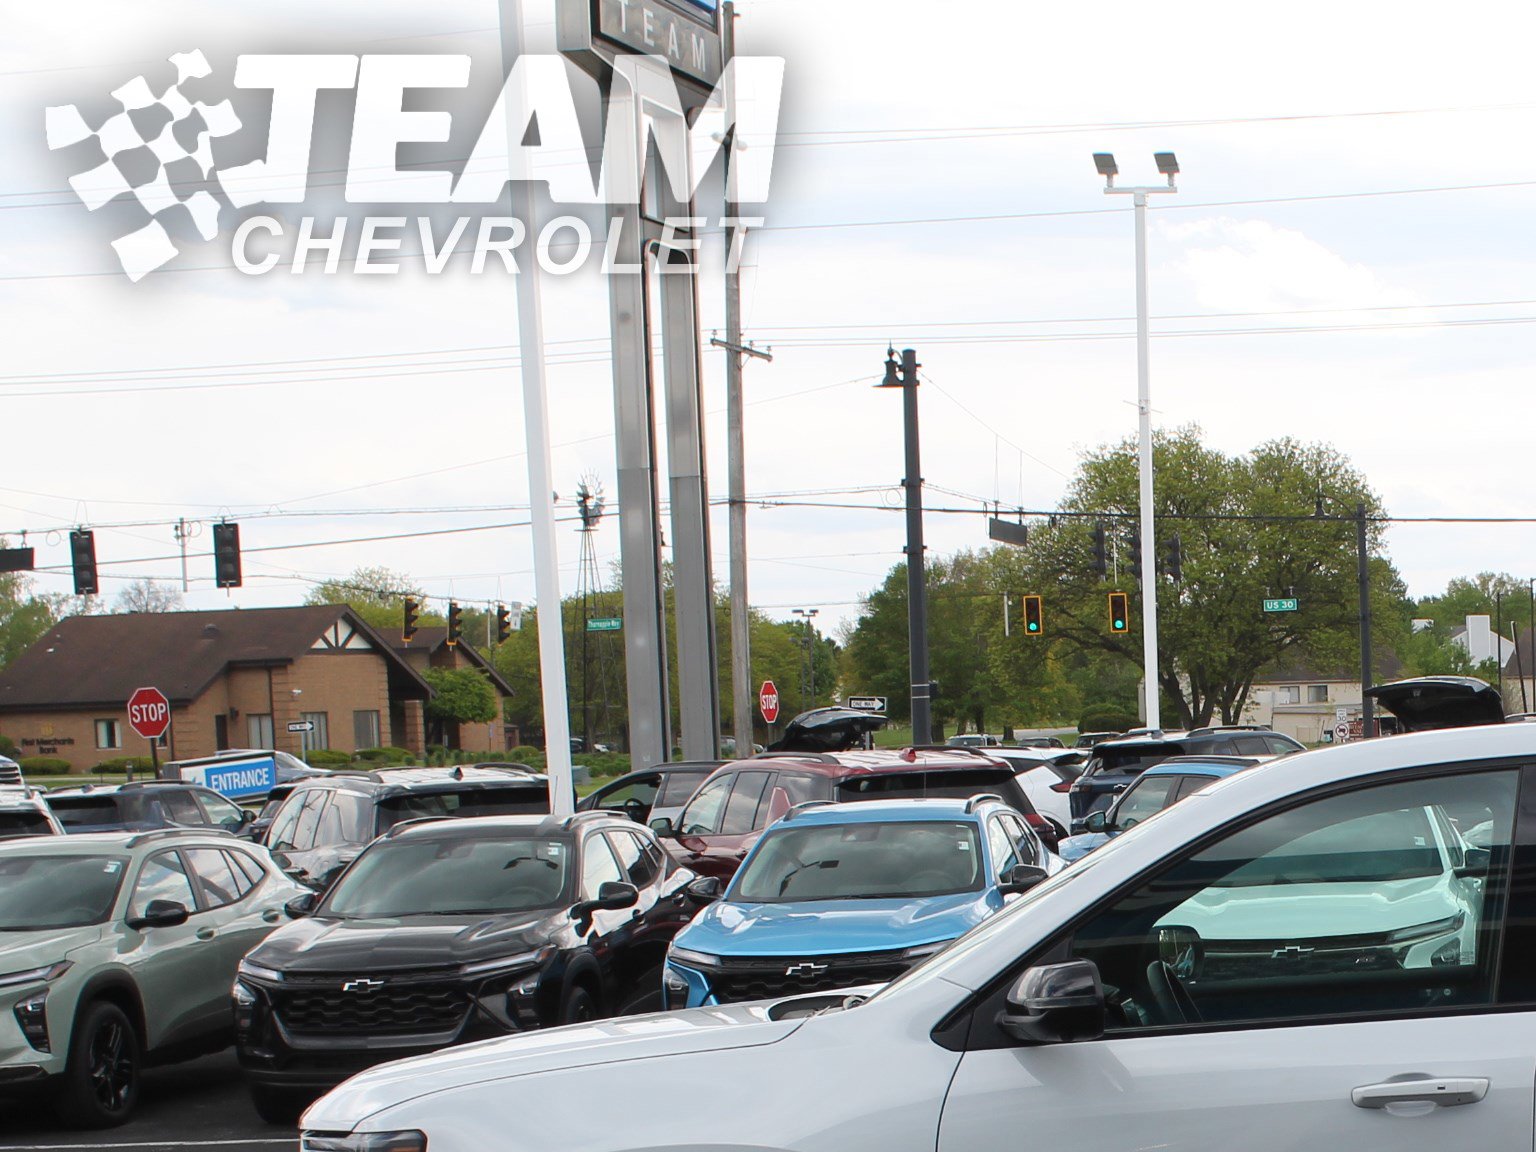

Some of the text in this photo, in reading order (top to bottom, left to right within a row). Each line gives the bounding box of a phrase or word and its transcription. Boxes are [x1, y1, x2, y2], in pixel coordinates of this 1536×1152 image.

[620, 0, 707, 73] TEAM
[1266, 600, 1294, 610] US 30
[131, 702, 167, 724] STOP
[760, 694, 777, 710] STOP
[211, 767, 271, 791] ENTRANCE
